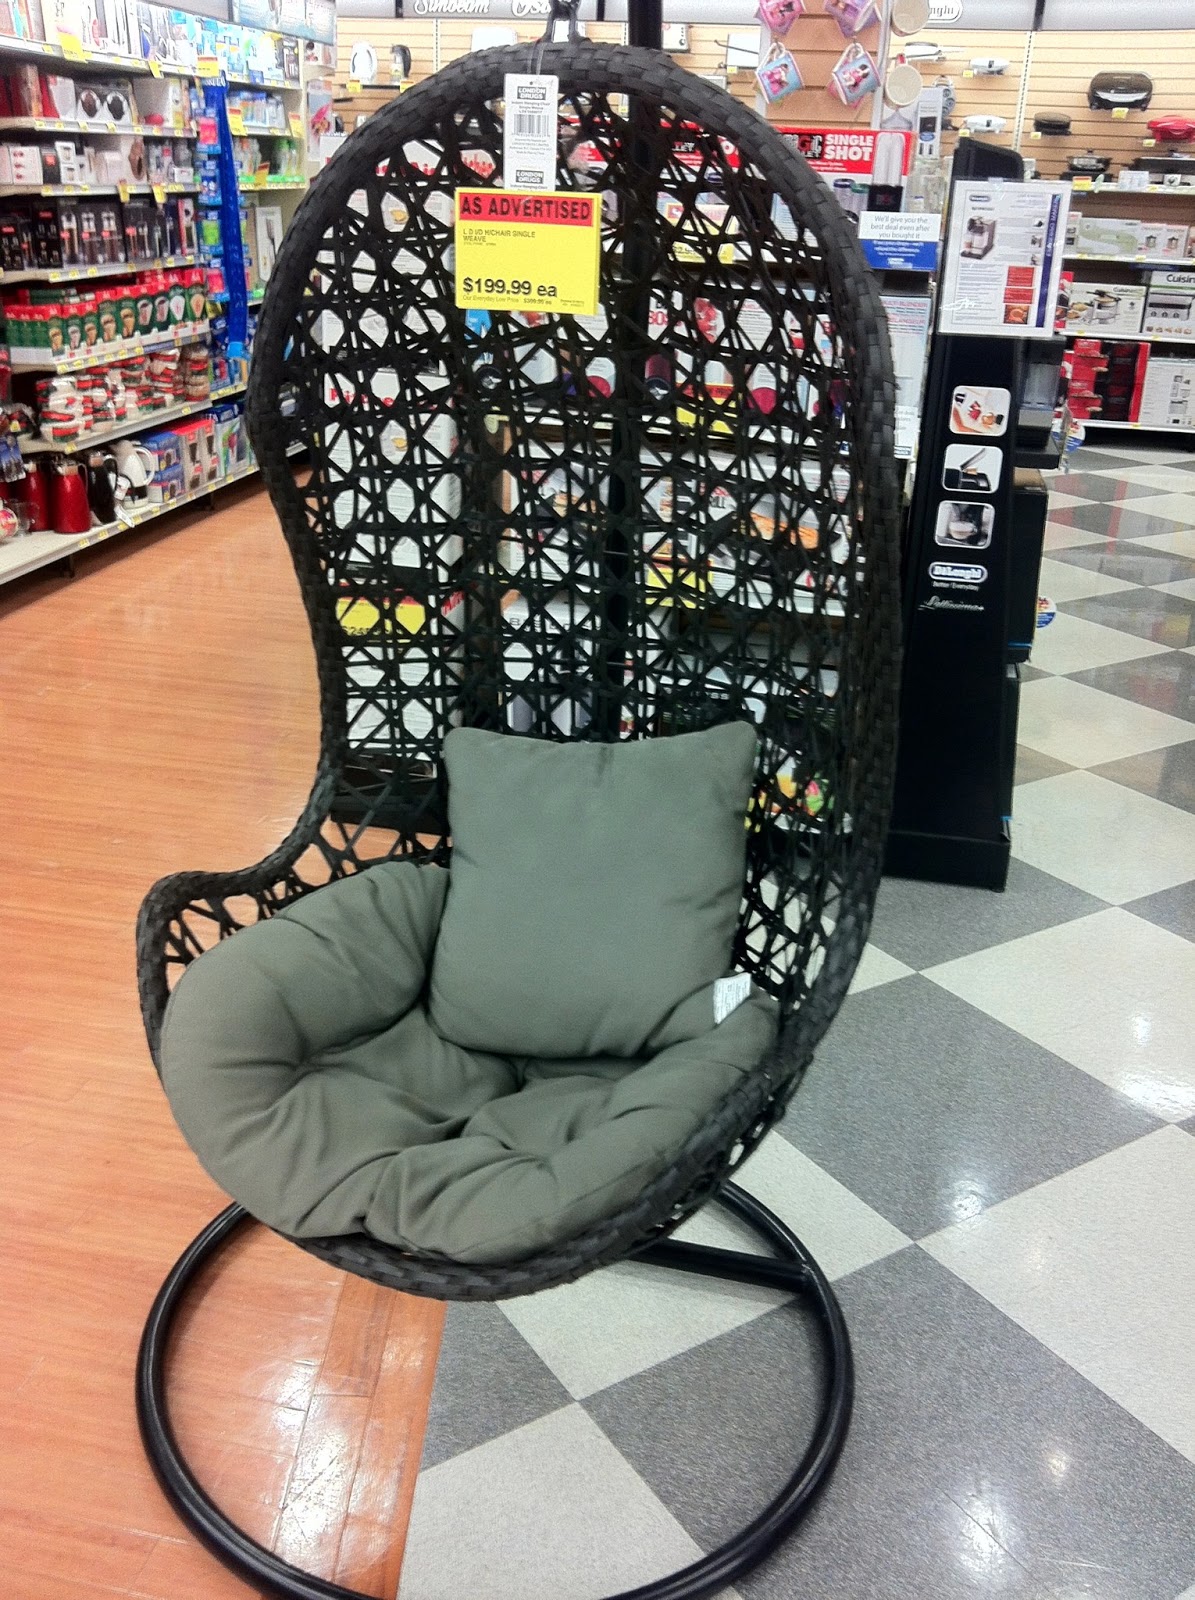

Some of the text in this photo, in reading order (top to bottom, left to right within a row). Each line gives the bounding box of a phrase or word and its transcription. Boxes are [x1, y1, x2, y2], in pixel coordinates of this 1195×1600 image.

[825, 134, 874, 147] SINGLE
[824, 145, 872, 161] SHOT
[461, 196, 590, 220] AS ADVERTISED
[512, 230, 536, 238] SINGLE
[892, 232, 914, 240] bought
[1166, 273, 1195, 284] Cuisin
[463, 277, 558, 298] $199.99 ea
[473, 295, 495, 303] Everyday
